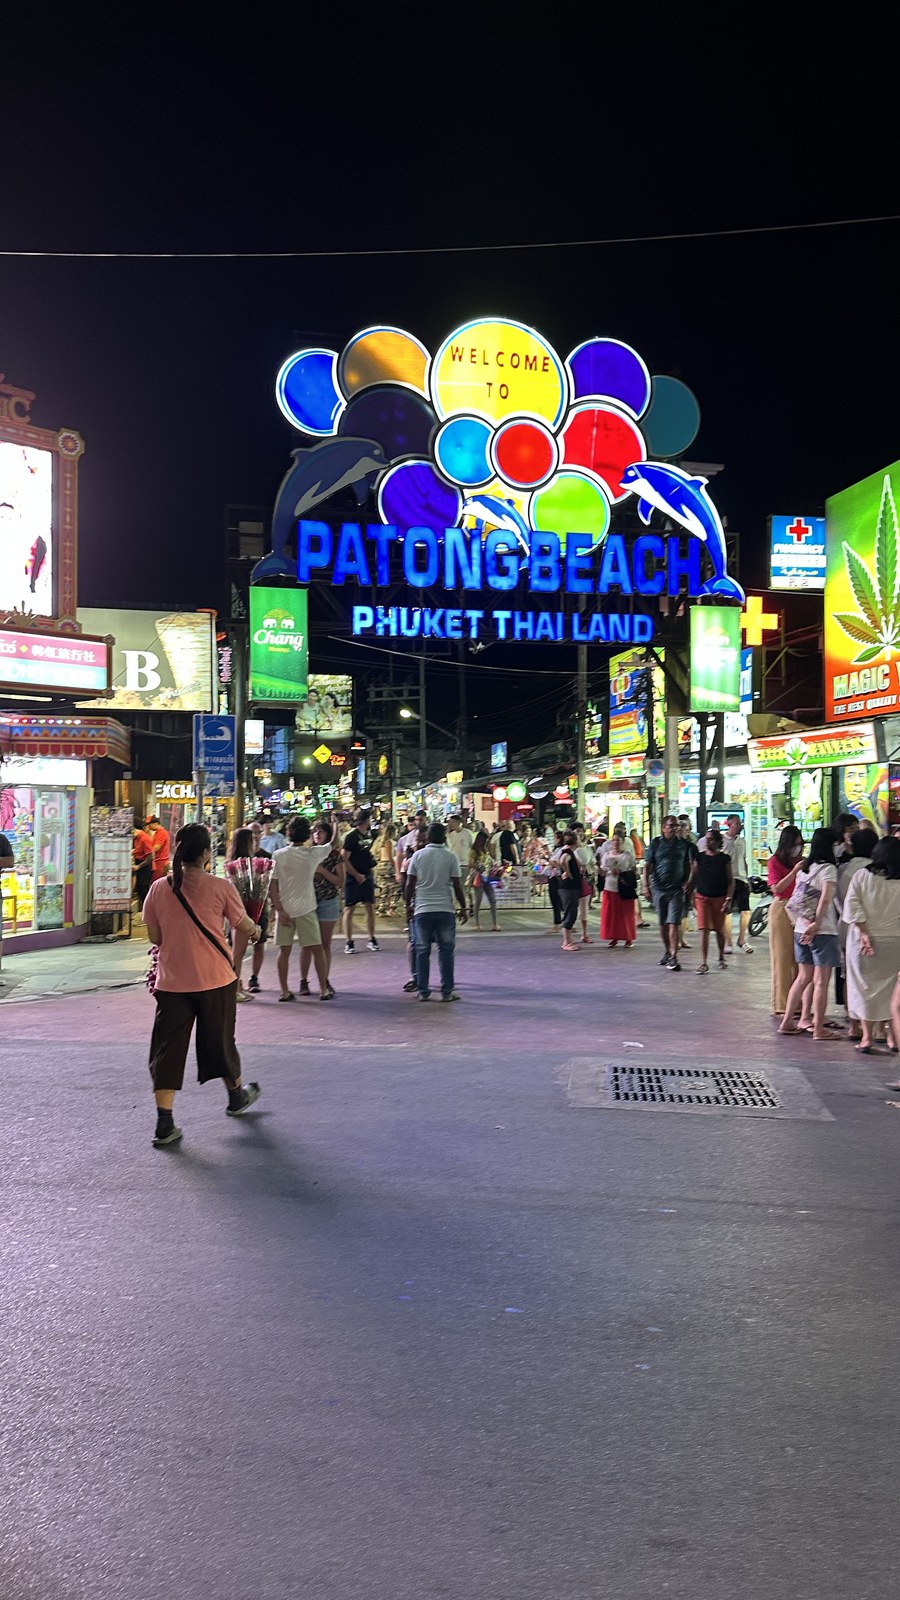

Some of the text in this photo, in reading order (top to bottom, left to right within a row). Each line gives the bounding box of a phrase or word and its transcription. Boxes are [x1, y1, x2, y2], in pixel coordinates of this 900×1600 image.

[450, 345, 550, 373] WELCOME
[486, 382, 509, 400] TO
[352, 605, 485, 640] PHUKET
[253, 629, 305, 652] Chang
[833, 664, 891, 701] MAGIC
